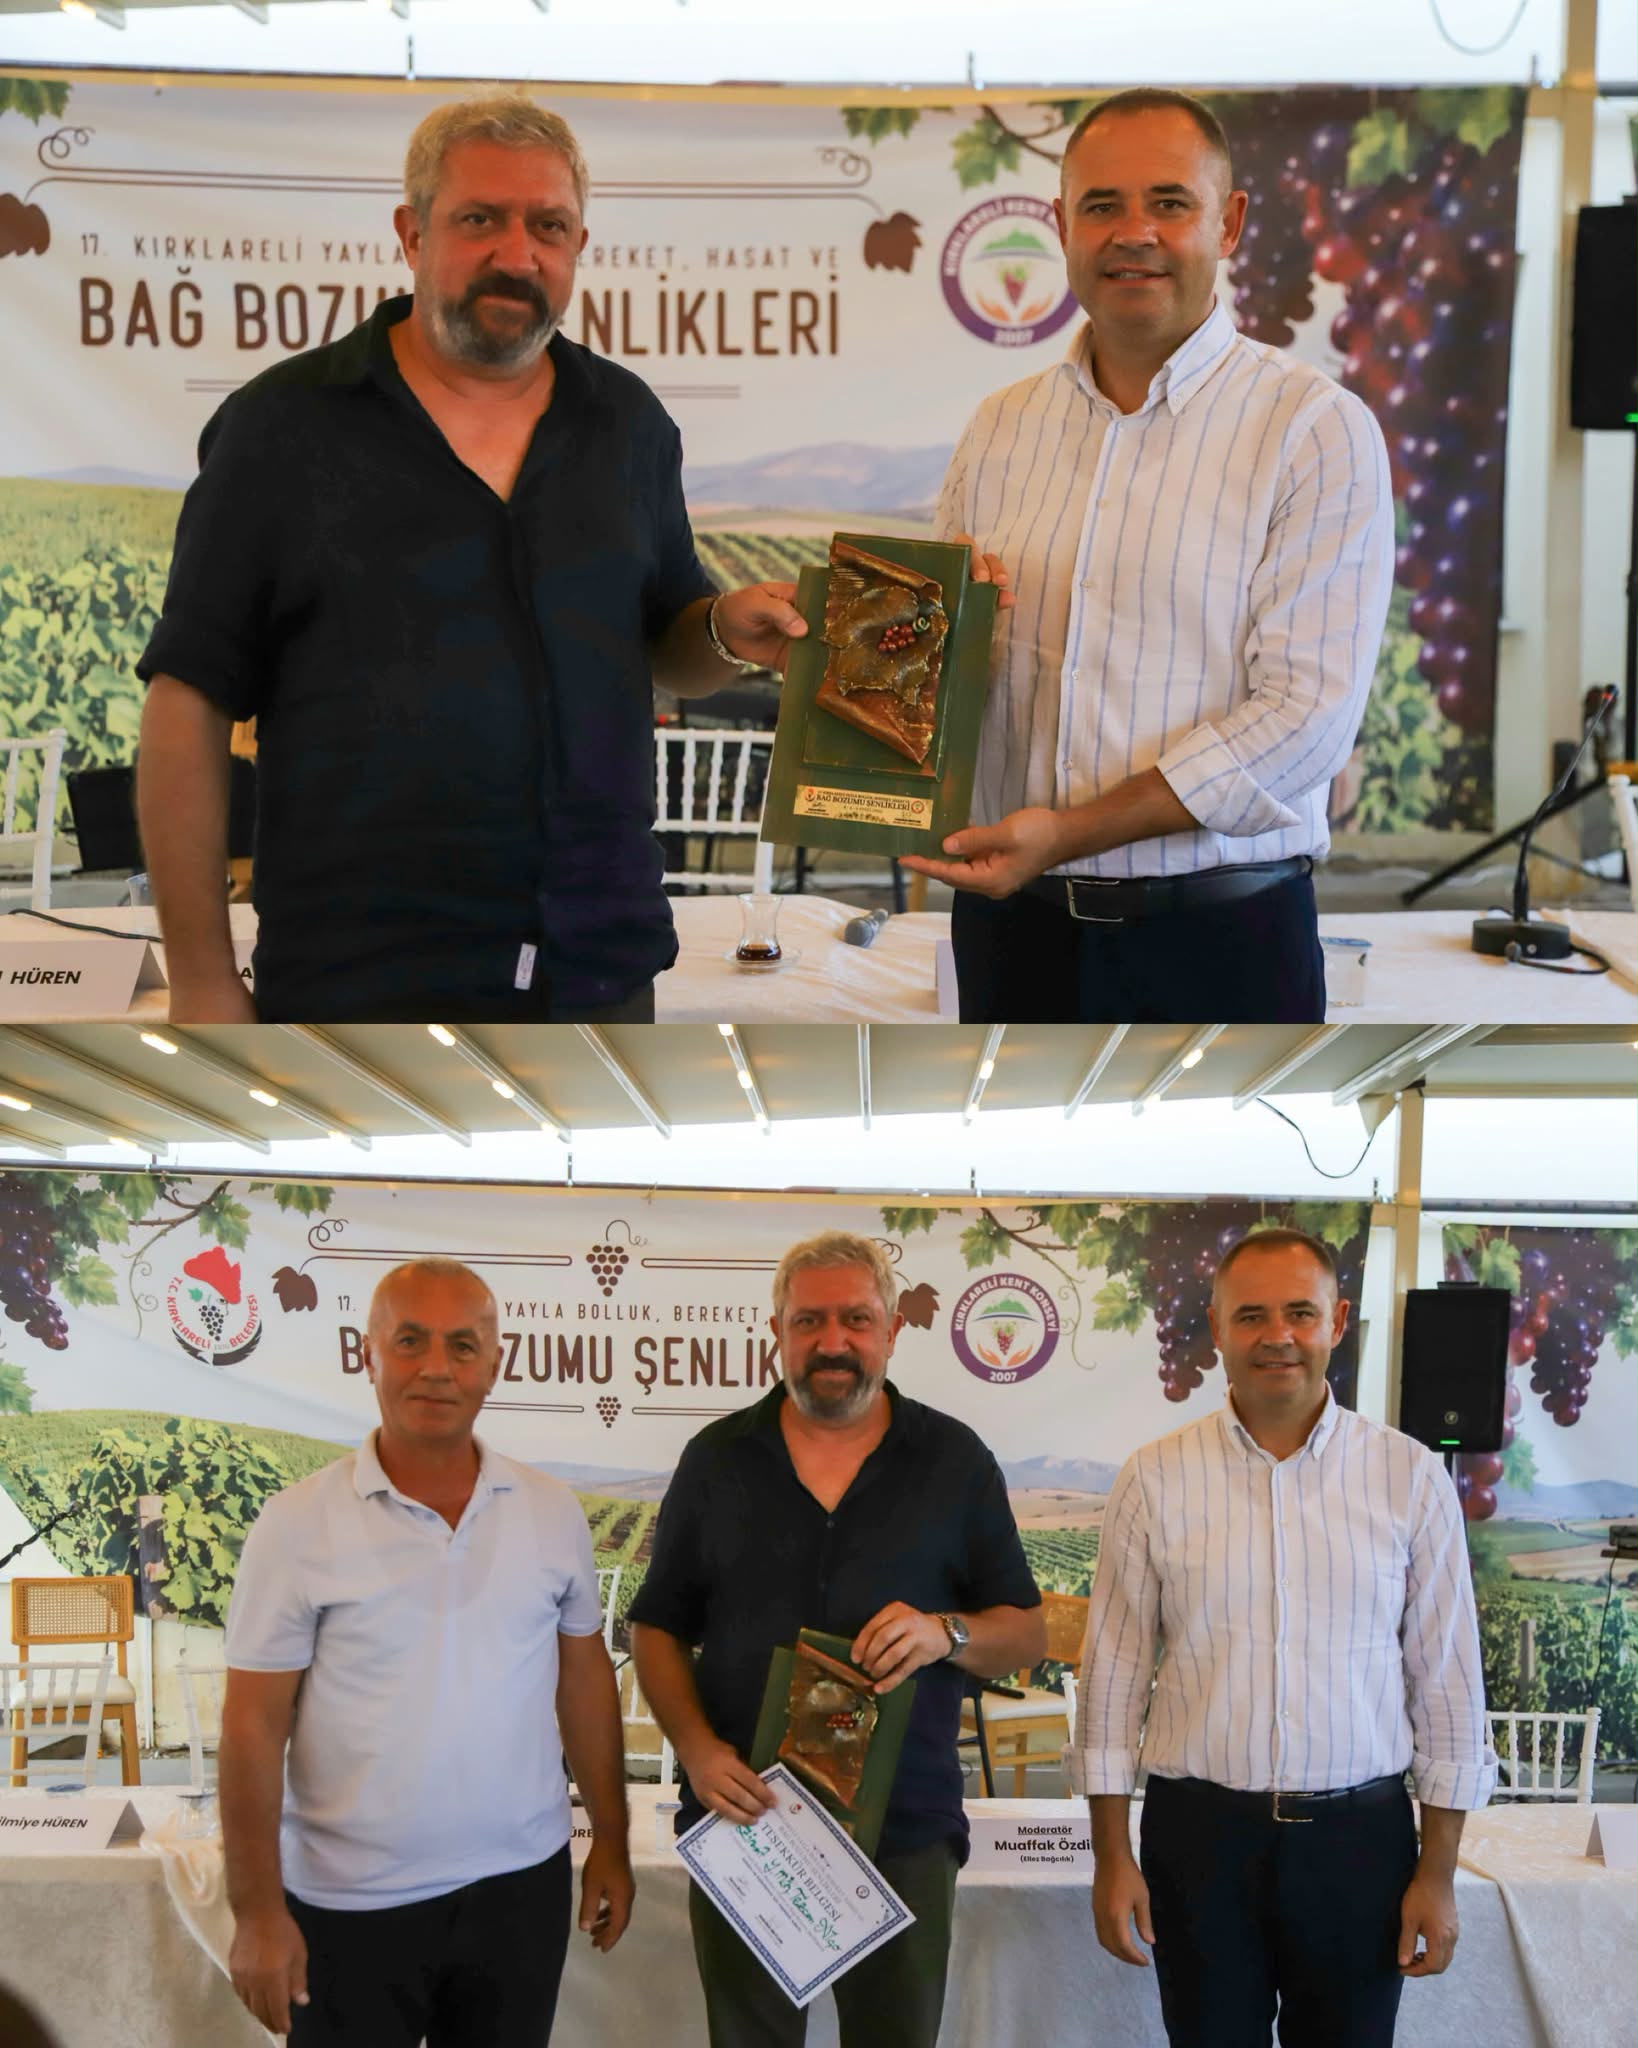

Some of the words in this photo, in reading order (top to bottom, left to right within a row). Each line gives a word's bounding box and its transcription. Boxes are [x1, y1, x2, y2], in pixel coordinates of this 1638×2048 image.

[80, 234, 108, 257] 17.
[134, 235, 303, 264] KIRKLARELİ
[579, 246, 689, 271] EREKET,
[706, 245, 791, 268] HASAT
[810, 246, 839, 269] VE
[79, 266, 204, 349] BAĞ
[581, 274, 838, 356] NLİKLERİ
[10, 968, 82, 985] HÜREN
[338, 1295, 357, 1312] 17.
[505, 1302, 564, 1319] YAYLA
[578, 1304, 661, 1323] BOLLUK,
[674, 1305, 768, 1326] BEREKET,
[955, 1276, 998, 1331] KIRKLARELİ
[1000, 1276, 1031, 1291] KENT
[1029, 1286, 1059, 1332] KONSEYİ
[501, 1332, 613, 1385] ZUMU
[634, 1326, 779, 1396] ŞENLİK
[989, 1371, 1018, 1382] 2007
[41, 1816, 88, 1828] HÜREN
[1018, 1825, 1072, 1835] Moderatör
[995, 1840, 1055, 1851] Muaffak
[1059, 1837, 1091, 1851] Özdi
